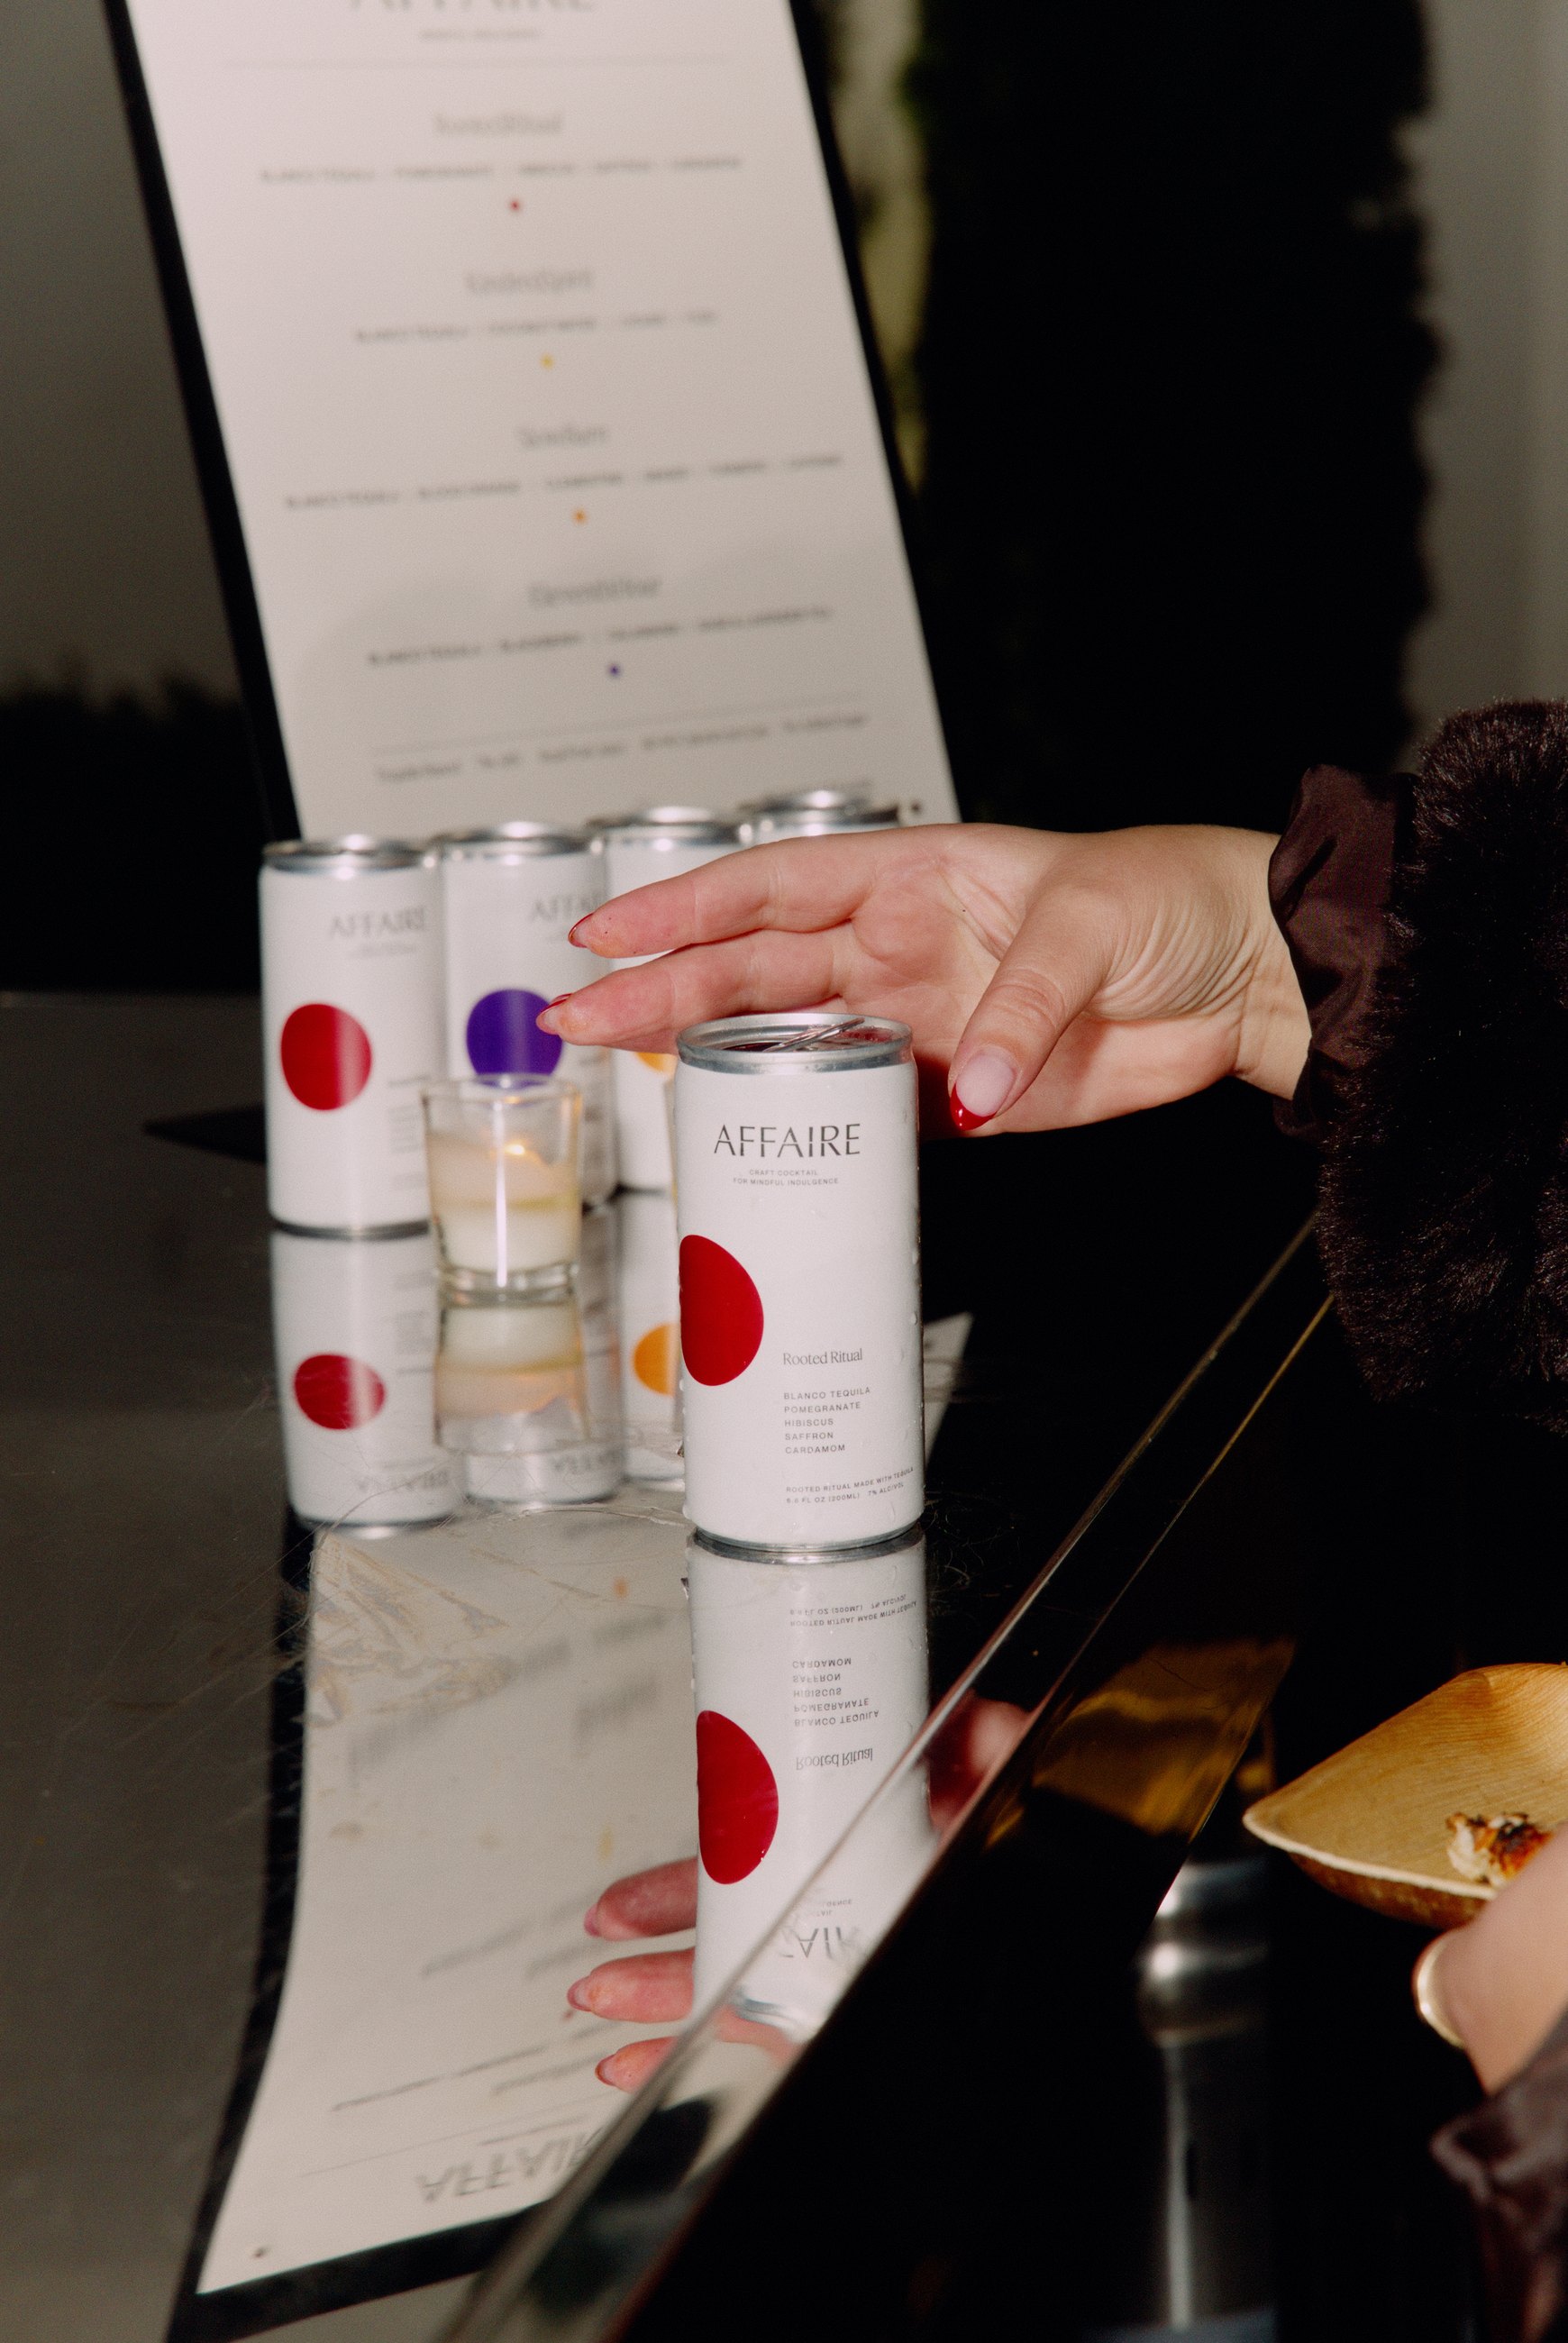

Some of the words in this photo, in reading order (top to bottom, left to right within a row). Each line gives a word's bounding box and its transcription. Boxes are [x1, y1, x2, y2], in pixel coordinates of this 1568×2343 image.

[714, 1123, 861, 1158] AFFAIRE
[750, 1178, 785, 1186] MINDFUL
[788, 1178, 839, 1186] INDULGENCE
[782, 1351, 827, 1365] Rooted
[830, 1348, 862, 1364] Ritual
[784, 1392, 826, 1400] BLANCO
[830, 1387, 871, 1399] TEQUILA
[784, 1401, 861, 1413] POMEGRANATE
[785, 1418, 834, 1427] HIBISCUS
[785, 1432, 834, 1441] SAFFRON
[785, 1445, 846, 1454] CARDAMOM
[786, 1486, 821, 1494] ROOTED
[823, 1483, 851, 1491] RITUAL
[853, 1479, 874, 1488] MADE
[876, 1474, 892, 1484] WITH
[893, 1467, 914, 1479] TEQUILA
[815, 1495, 825, 1503] OZ
